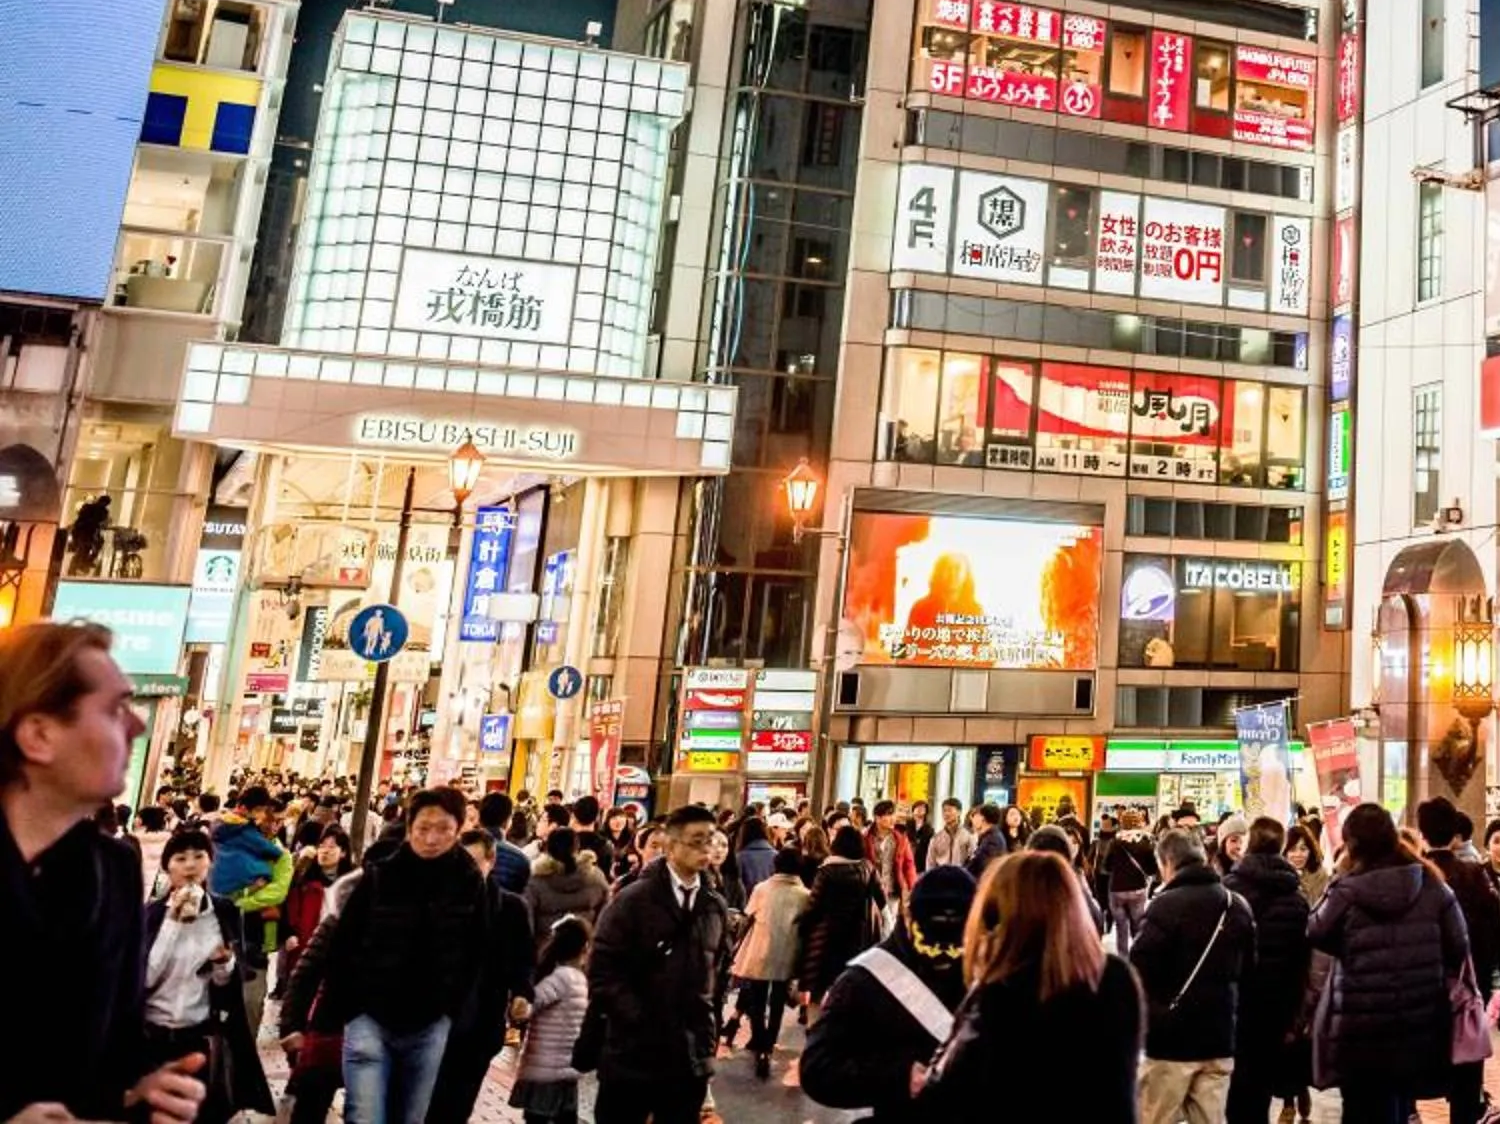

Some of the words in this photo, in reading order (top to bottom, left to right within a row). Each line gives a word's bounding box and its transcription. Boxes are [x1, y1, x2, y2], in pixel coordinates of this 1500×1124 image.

[930, 62, 963, 92] 5F
[1102, 213, 1222, 248] 女性のお客様
[1100, 237, 1173, 262] 飲み放題
[456, 264, 524, 292] なんば
[1174, 247, 1222, 283] 0円
[426, 287, 545, 333] 戎橋筋
[1132, 387, 1211, 437] 風月
[360, 418, 436, 445] EBISU
[1180, 752, 1239, 767] FamilyMar
